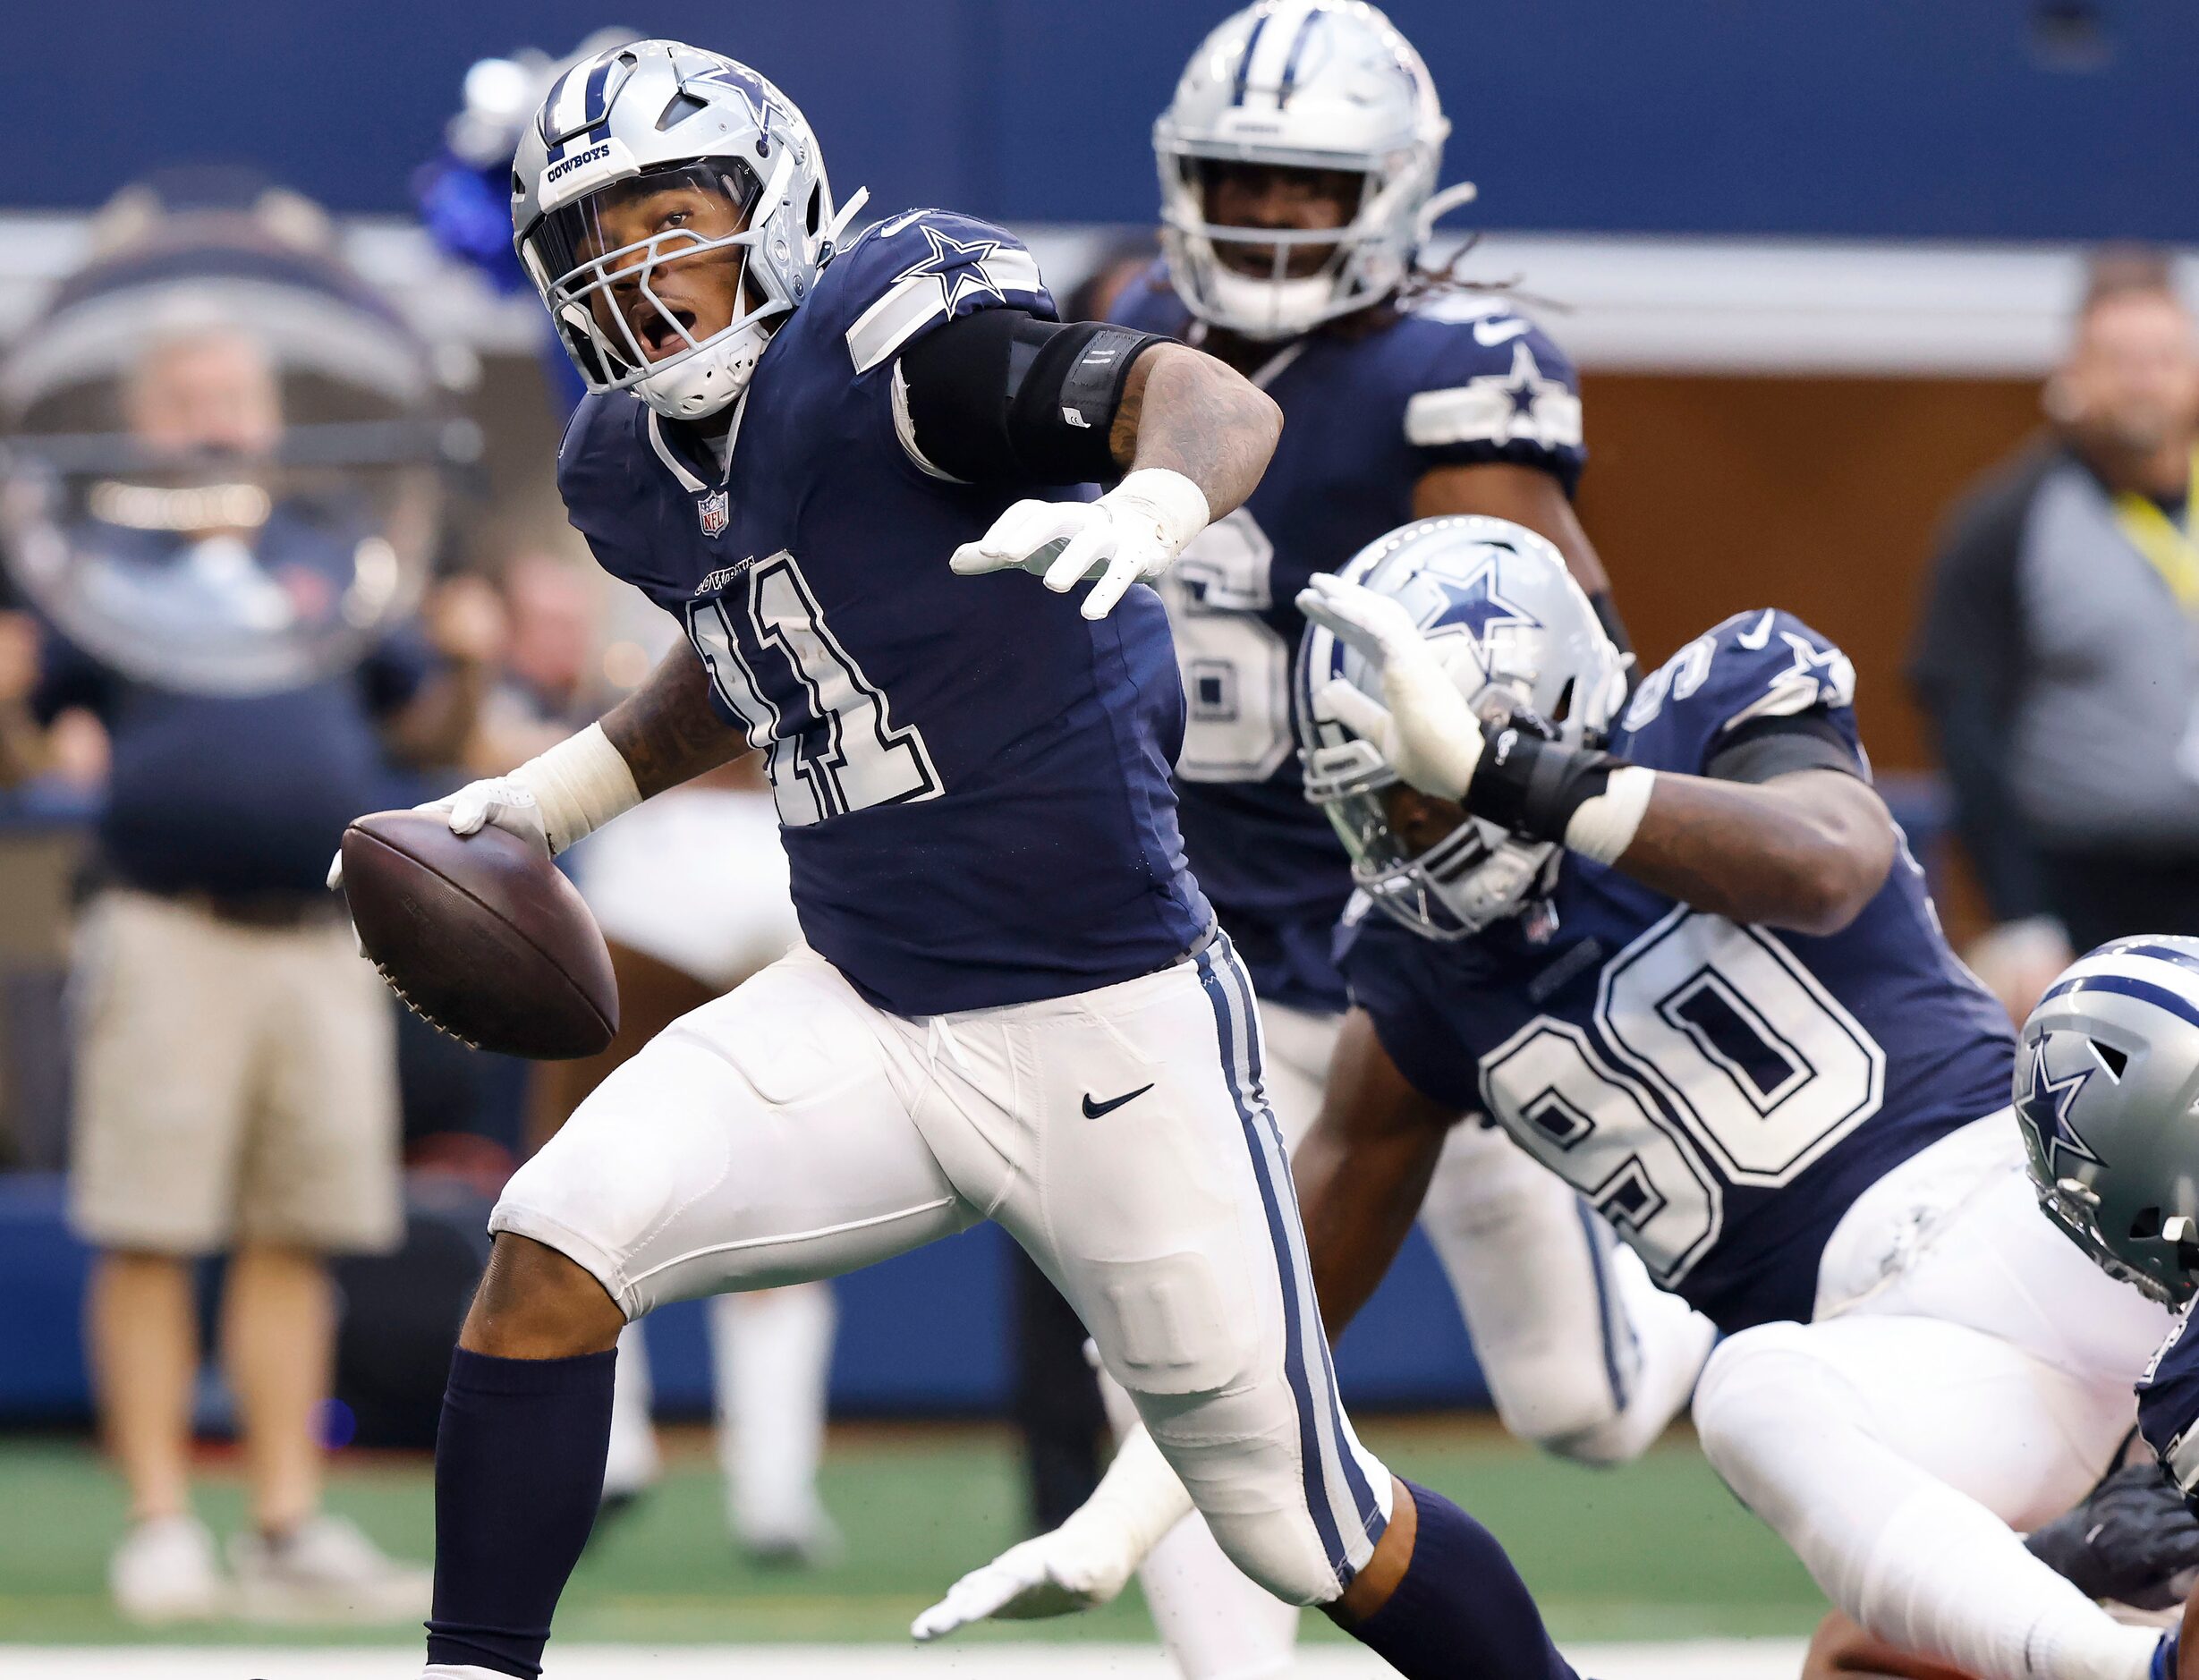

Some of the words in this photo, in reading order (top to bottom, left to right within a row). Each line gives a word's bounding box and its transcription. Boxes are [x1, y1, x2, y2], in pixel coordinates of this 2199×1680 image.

[548, 144, 610, 182] COWBOYS
[703, 511, 723, 530] NFL
[686, 547, 946, 826] 11
[1479, 902, 1886, 1289] 90
